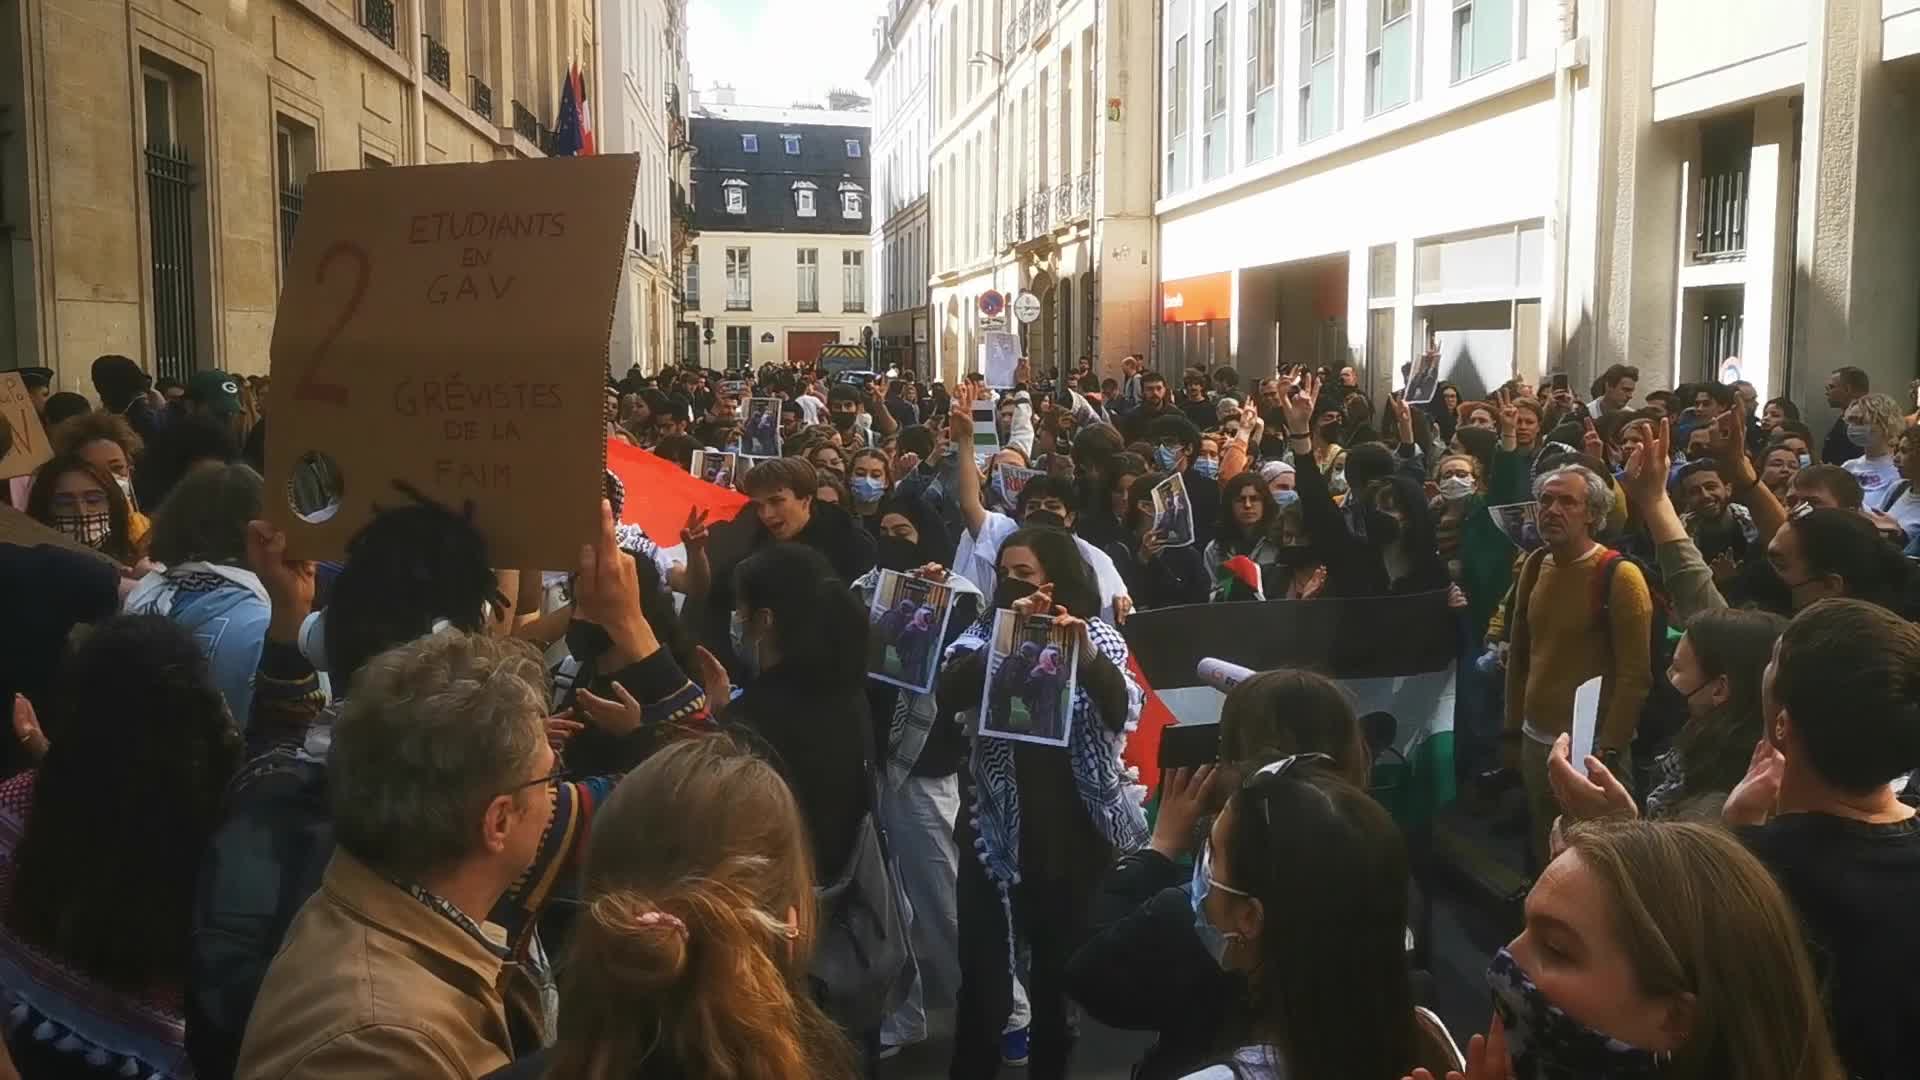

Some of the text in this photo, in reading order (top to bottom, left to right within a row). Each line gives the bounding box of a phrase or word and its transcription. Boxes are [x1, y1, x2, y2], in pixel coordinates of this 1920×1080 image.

[408, 211, 566, 245] ETUDIANTS
[461, 247, 492, 268] EN
[296, 238, 373, 407] 2
[222, 381, 238, 393] G
[394, 371, 563, 416] GRÉVISTES
[444, 420, 520, 441] DE LA
[434, 459, 512, 488] FAIM
